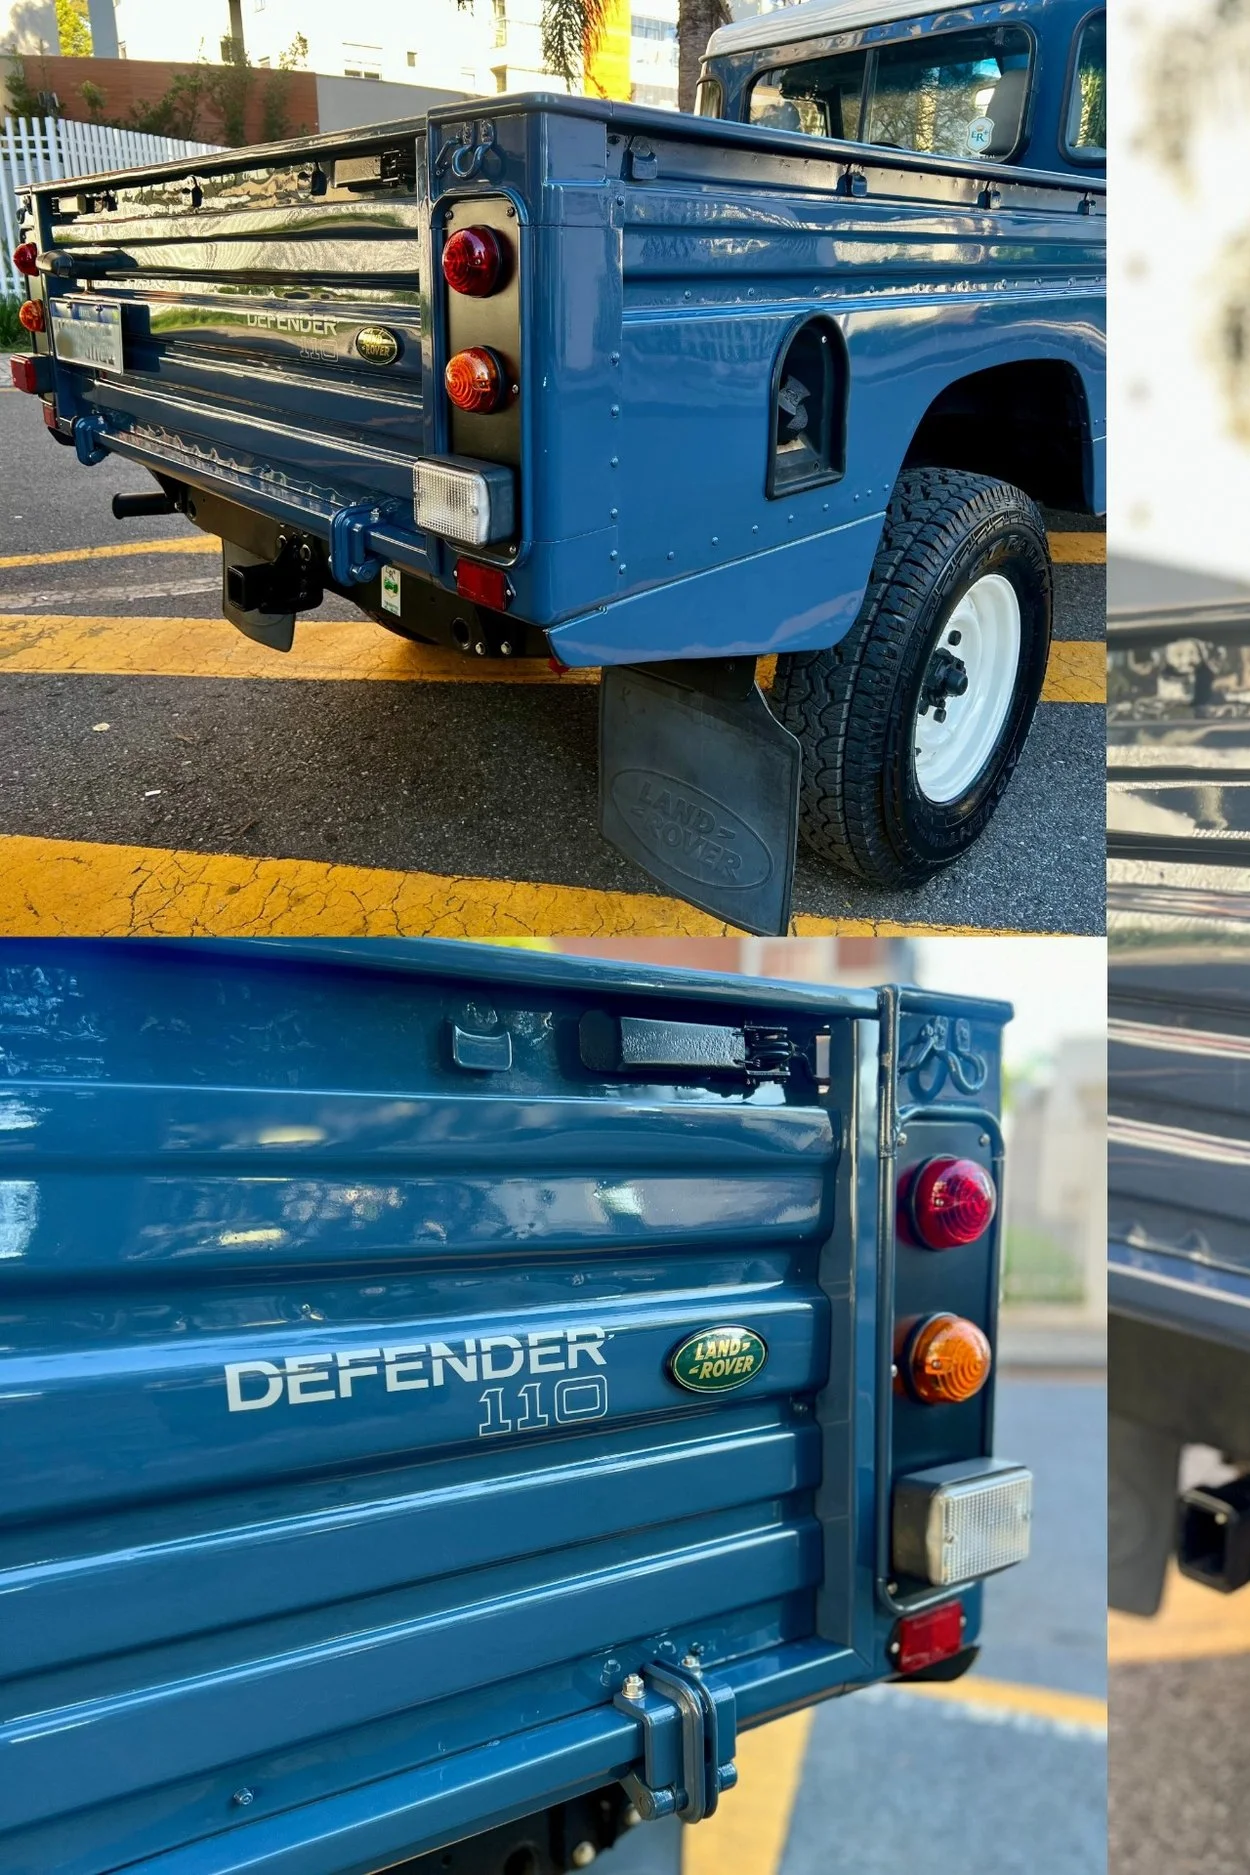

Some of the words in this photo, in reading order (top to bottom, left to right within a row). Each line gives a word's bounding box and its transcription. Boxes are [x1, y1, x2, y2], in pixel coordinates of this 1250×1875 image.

[247, 311, 338, 336] DEFENDER
[300, 336, 338, 362] 110
[365, 343, 390, 357] ROVER
[638, 781, 716, 835] LAND
[643, 814, 742, 882] ROVER
[694, 1338, 741, 1361] LAND
[224, 1326, 607, 1413] DEFENDER
[698, 1355, 755, 1380] ROVER
[478, 1375, 608, 1437] 110
